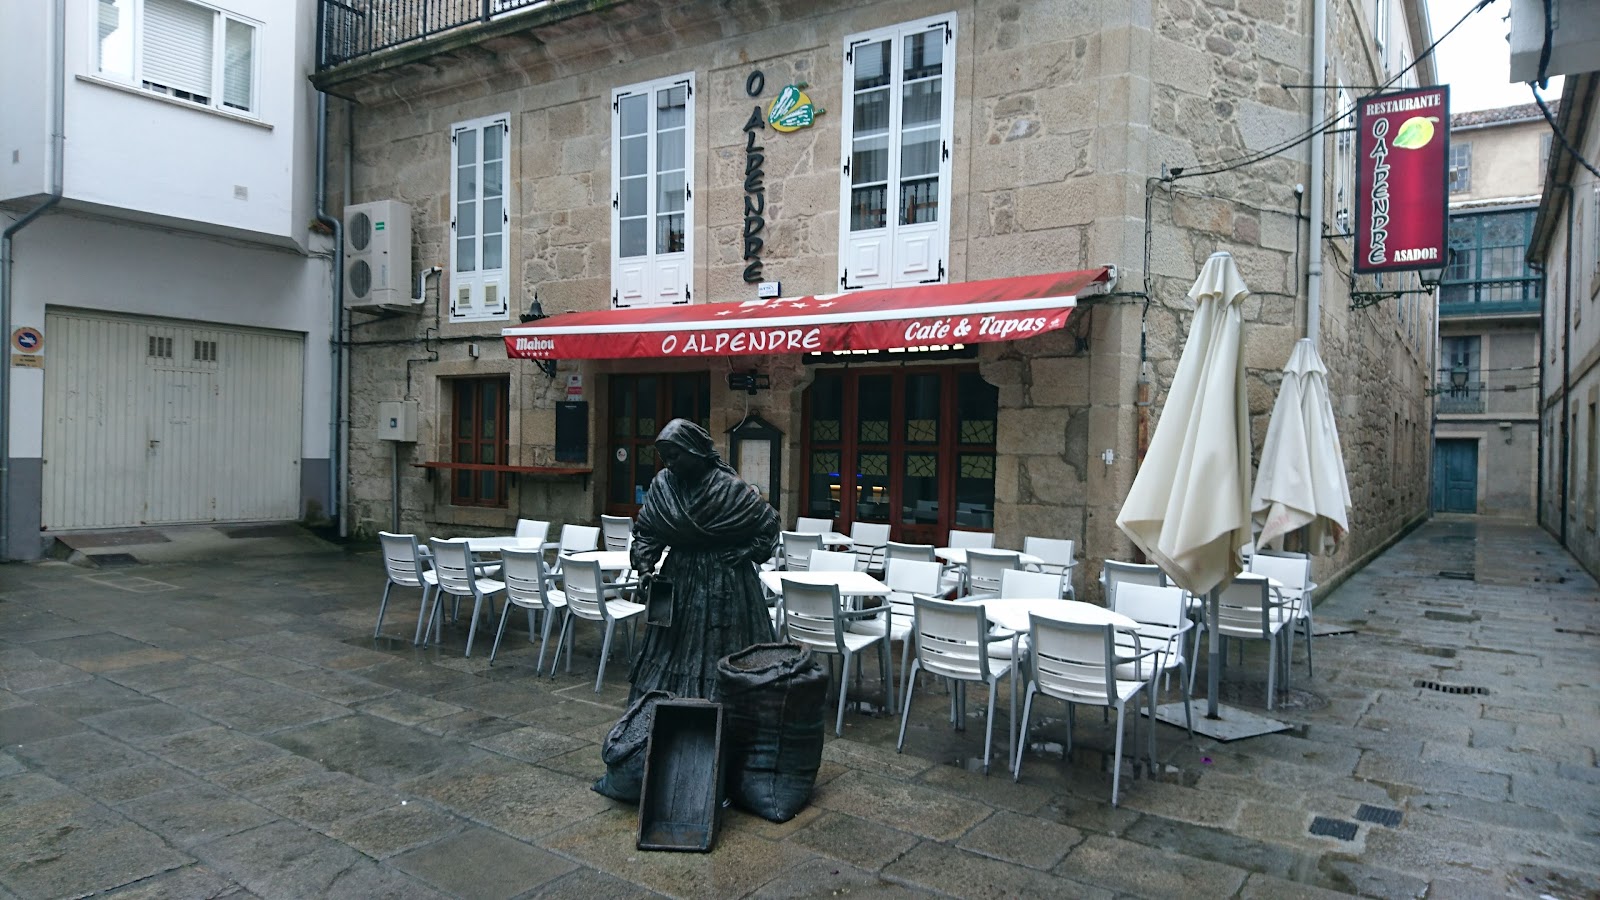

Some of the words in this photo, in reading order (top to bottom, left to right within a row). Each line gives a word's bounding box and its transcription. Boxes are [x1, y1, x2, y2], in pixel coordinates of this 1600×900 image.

[746, 70, 765, 97] O
[1366, 94, 1441, 116] RESTAURANTE
[1373, 118, 1389, 139] O
[743, 106, 765, 283] ALPENDRE
[1368, 138, 1391, 264] ALPENDRE
[1393, 247, 1438, 262] ASADOR
[661, 334, 678, 354] O
[682, 328, 821, 353] ALPENDRE
[904, 318, 951, 341] Café
[952, 317, 972, 338] &
[979, 316, 1047, 339] Tapas
[515, 336, 555, 351] Mahou
